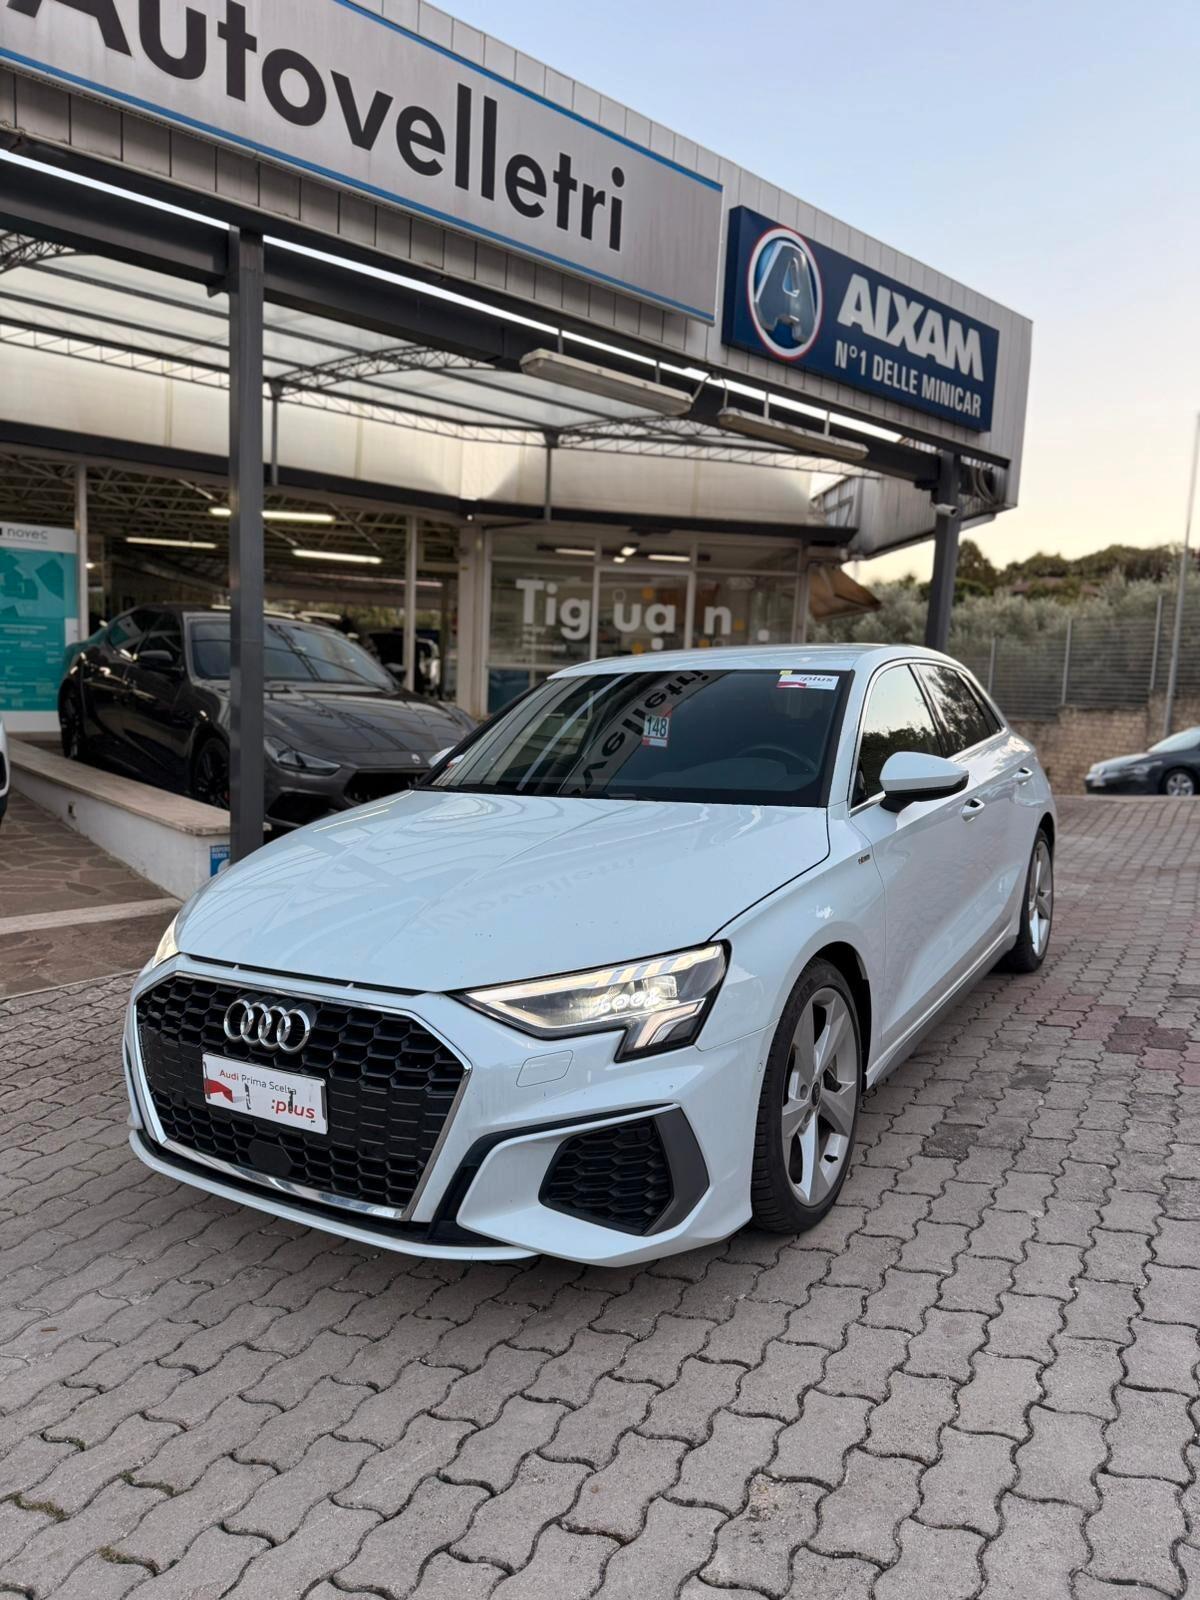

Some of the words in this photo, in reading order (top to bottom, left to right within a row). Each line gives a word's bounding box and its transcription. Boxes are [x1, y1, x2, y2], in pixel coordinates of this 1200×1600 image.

[836, 273, 984, 382] AIXAM
[872, 356, 918, 395] DELLE
[921, 373, 982, 418] MINICAR
[646, 715, 668, 737] 148
[219, 1069, 239, 1081] Audi
[241, 1074, 267, 1089] Prima
[269, 1081, 297, 1096] Scelta
